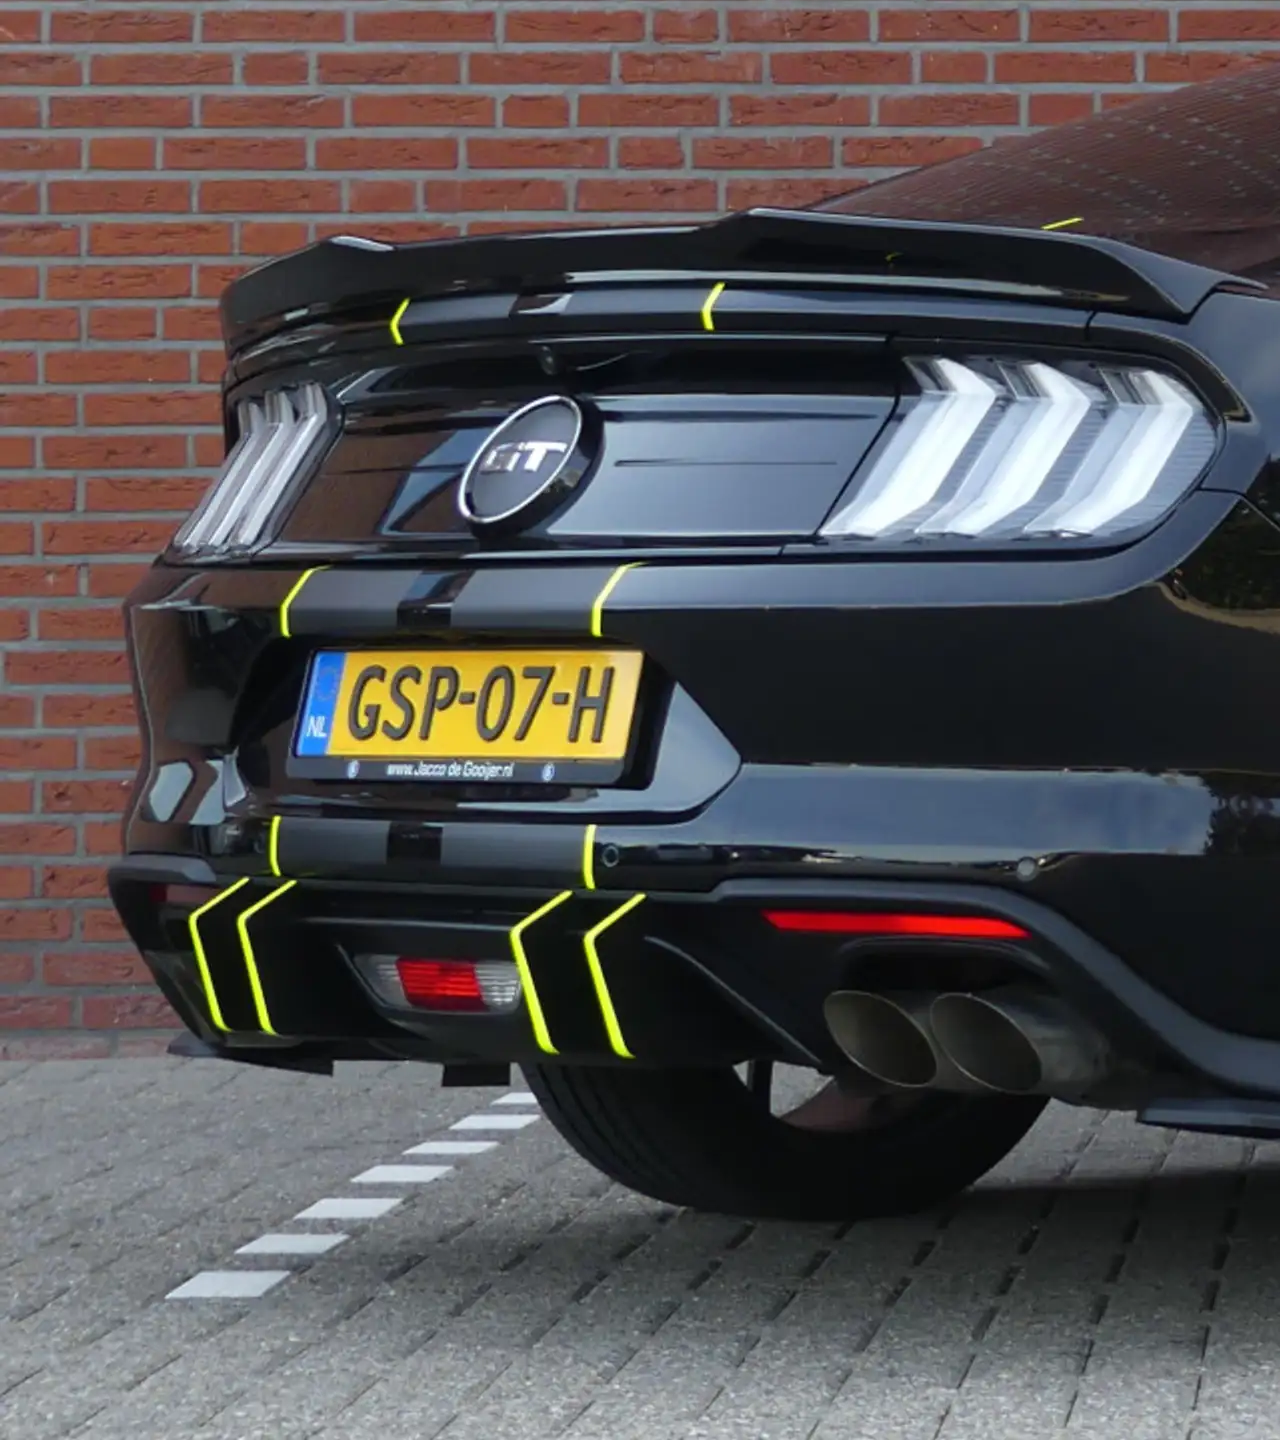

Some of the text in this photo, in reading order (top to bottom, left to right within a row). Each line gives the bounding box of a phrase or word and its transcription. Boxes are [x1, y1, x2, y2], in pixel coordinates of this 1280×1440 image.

[481, 441, 568, 473] GT
[347, 664, 615, 744] GSP-07-H
[306, 715, 328, 738] NL
